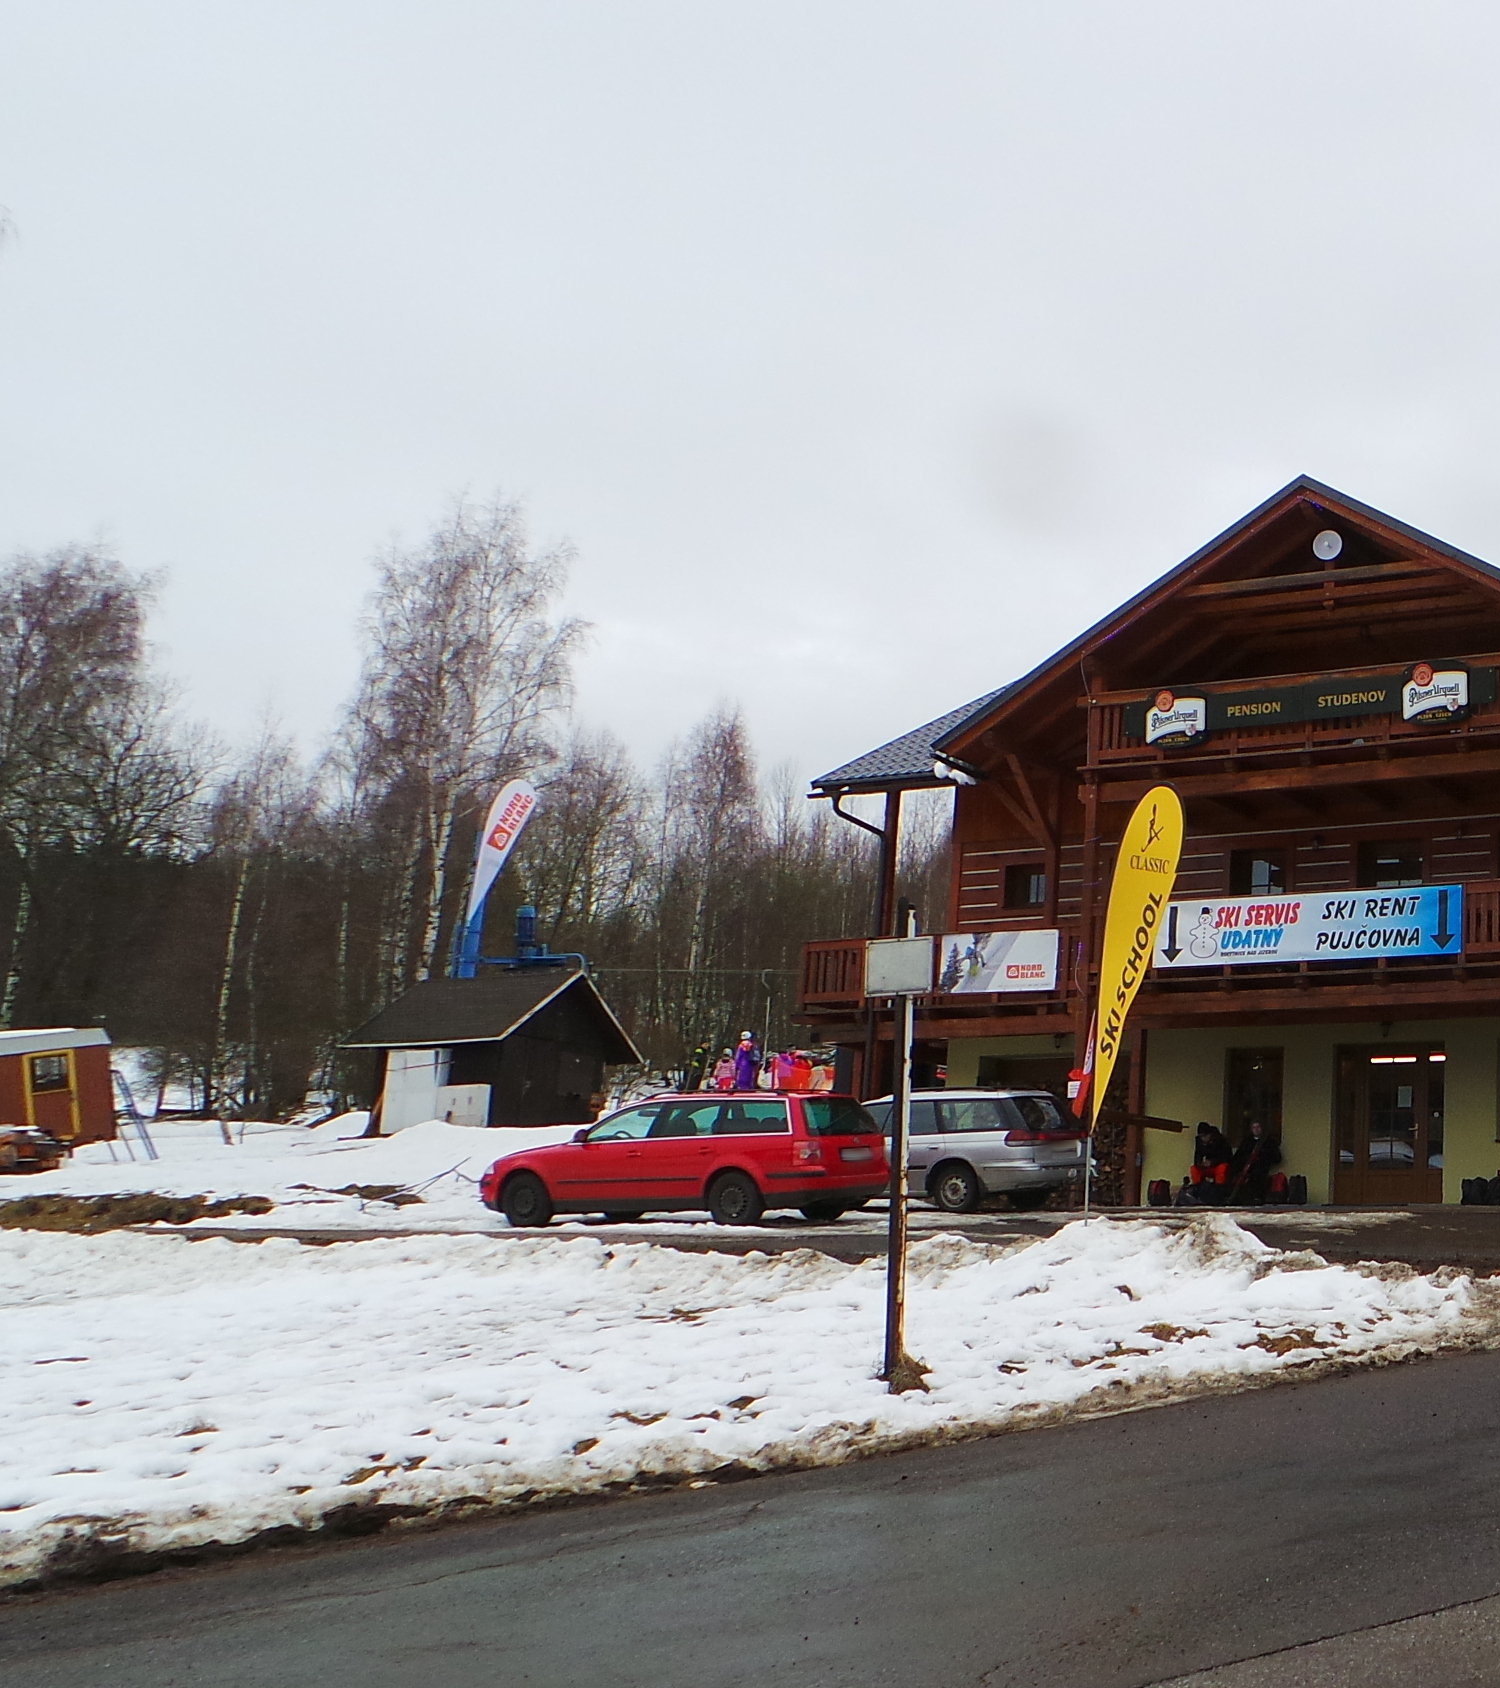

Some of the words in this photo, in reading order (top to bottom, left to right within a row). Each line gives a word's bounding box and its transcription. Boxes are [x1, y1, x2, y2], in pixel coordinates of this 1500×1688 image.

[1227, 702, 1282, 718] PENSION
[1318, 690, 1386, 708] STUDENOV
[1408, 688, 1433, 707] Pilsner
[1433, 683, 1460, 698] Urquell
[1152, 713, 1173, 732] Pilsner
[1173, 709, 1198, 722] Urquell
[499, 792, 522, 825] NORD
[508, 795, 533, 830] BLANC
[1130, 854, 1170, 875] CLASSIC
[1215, 906, 1242, 929] SKI
[1244, 902, 1301, 926] SERVIS
[1322, 900, 1356, 920] SKI
[1364, 896, 1420, 918] RENT
[1220, 923, 1284, 950] UDATNÝ
[1020, 971, 1046, 979] BLANC
[1100, 1007, 1122, 1060] SKI
[1116, 892, 1163, 1008] SCHOOL
